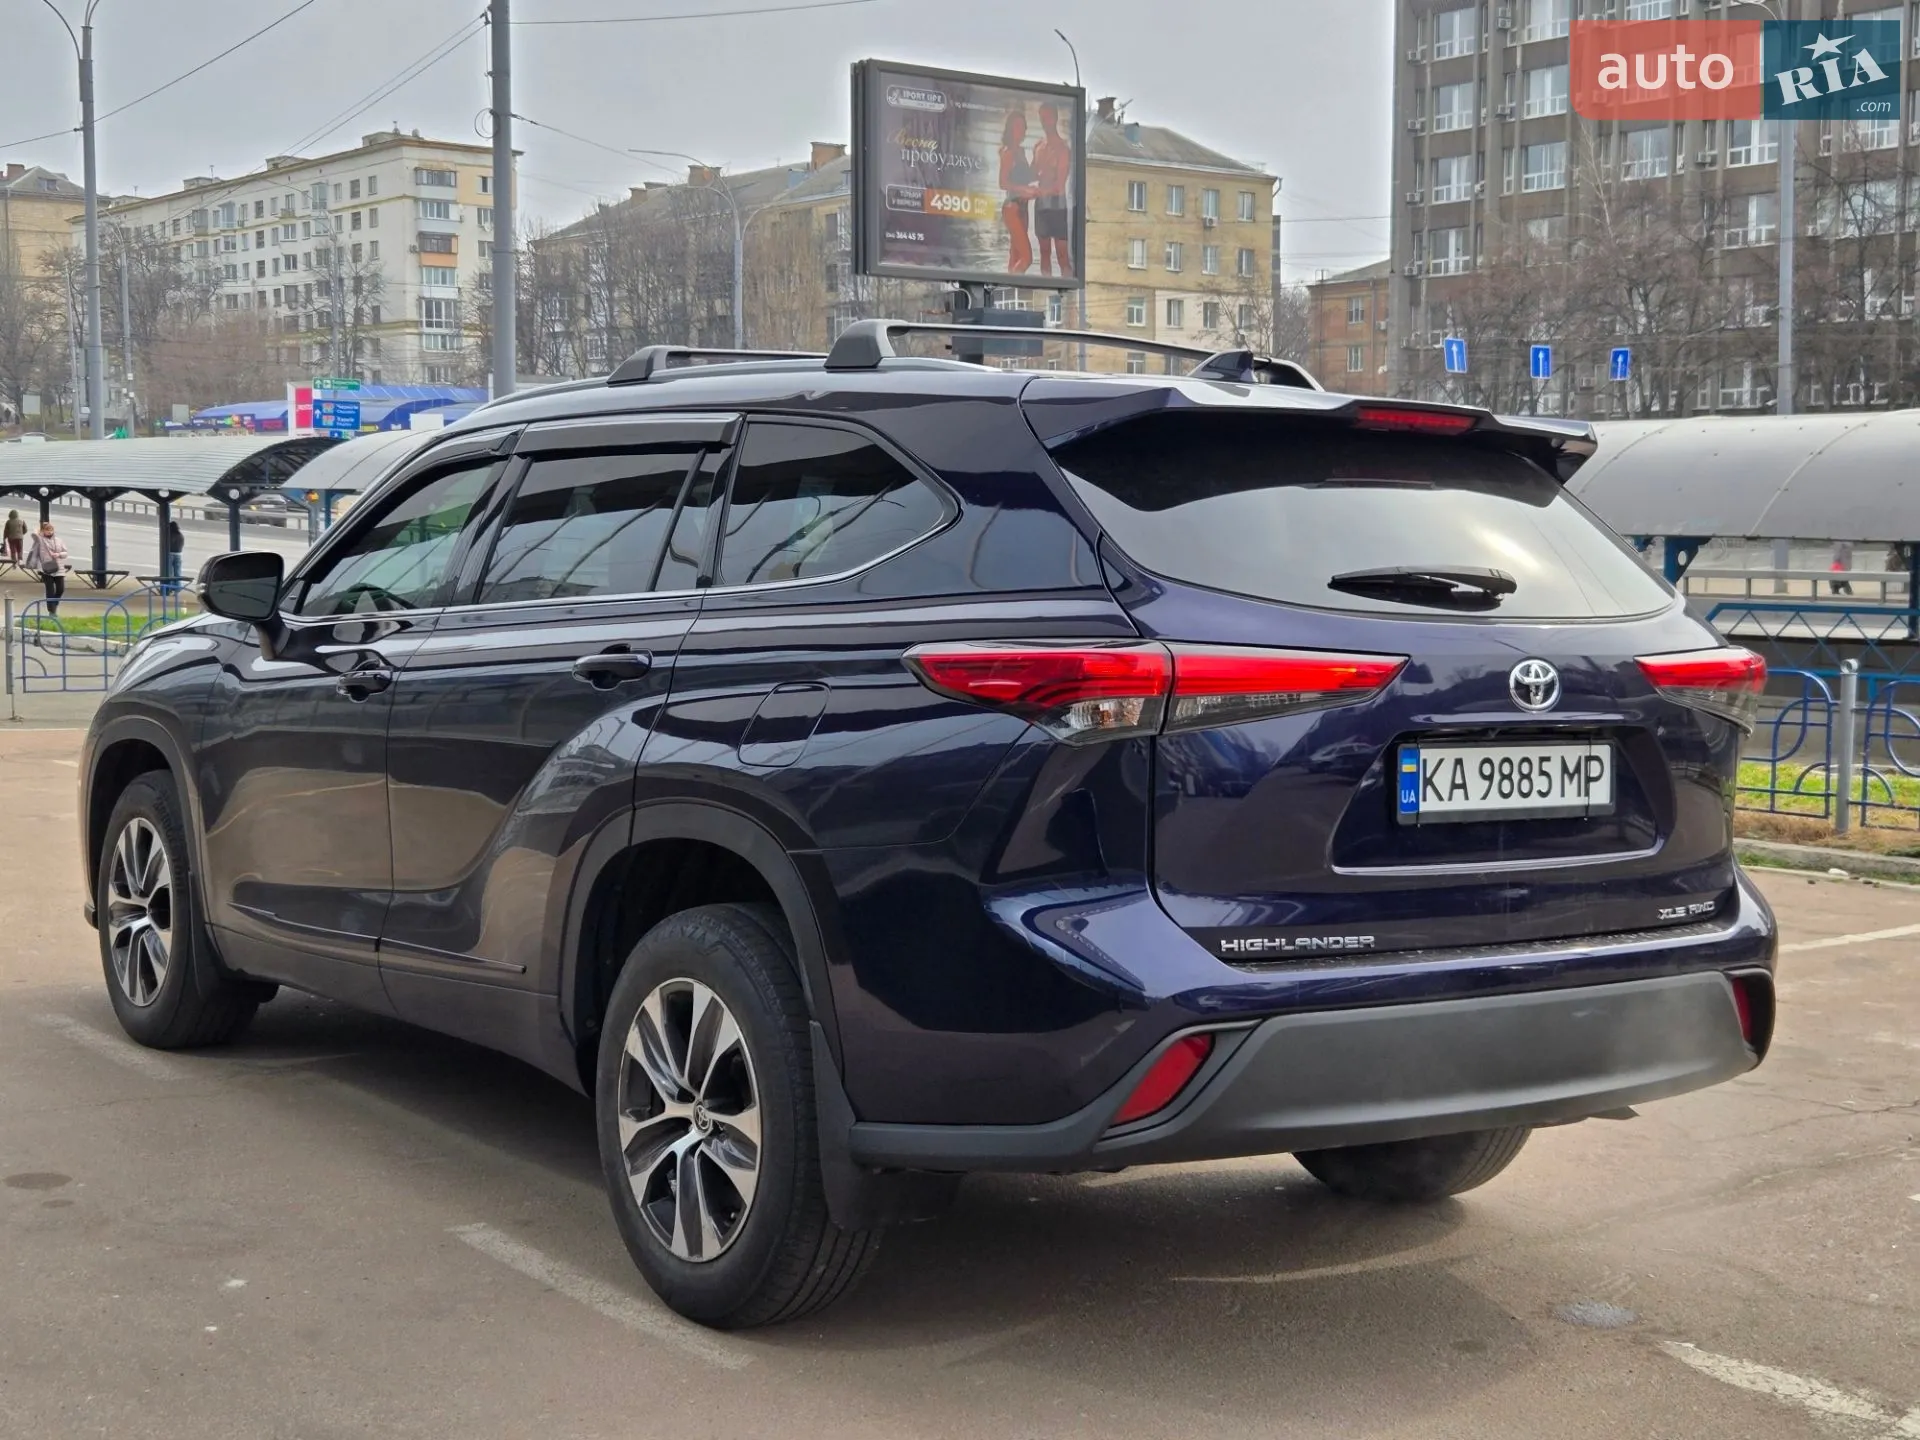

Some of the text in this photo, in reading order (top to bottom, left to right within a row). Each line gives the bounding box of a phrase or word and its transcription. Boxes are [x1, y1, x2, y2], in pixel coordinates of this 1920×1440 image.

[930, 194, 970, 213] 4990
[1421, 755, 1605, 802] KA 9885 MP
[1401, 789, 1417, 804] UA
[1657, 906, 1686, 920] XLE
[1220, 935, 1375, 952] HIGHLANDER
